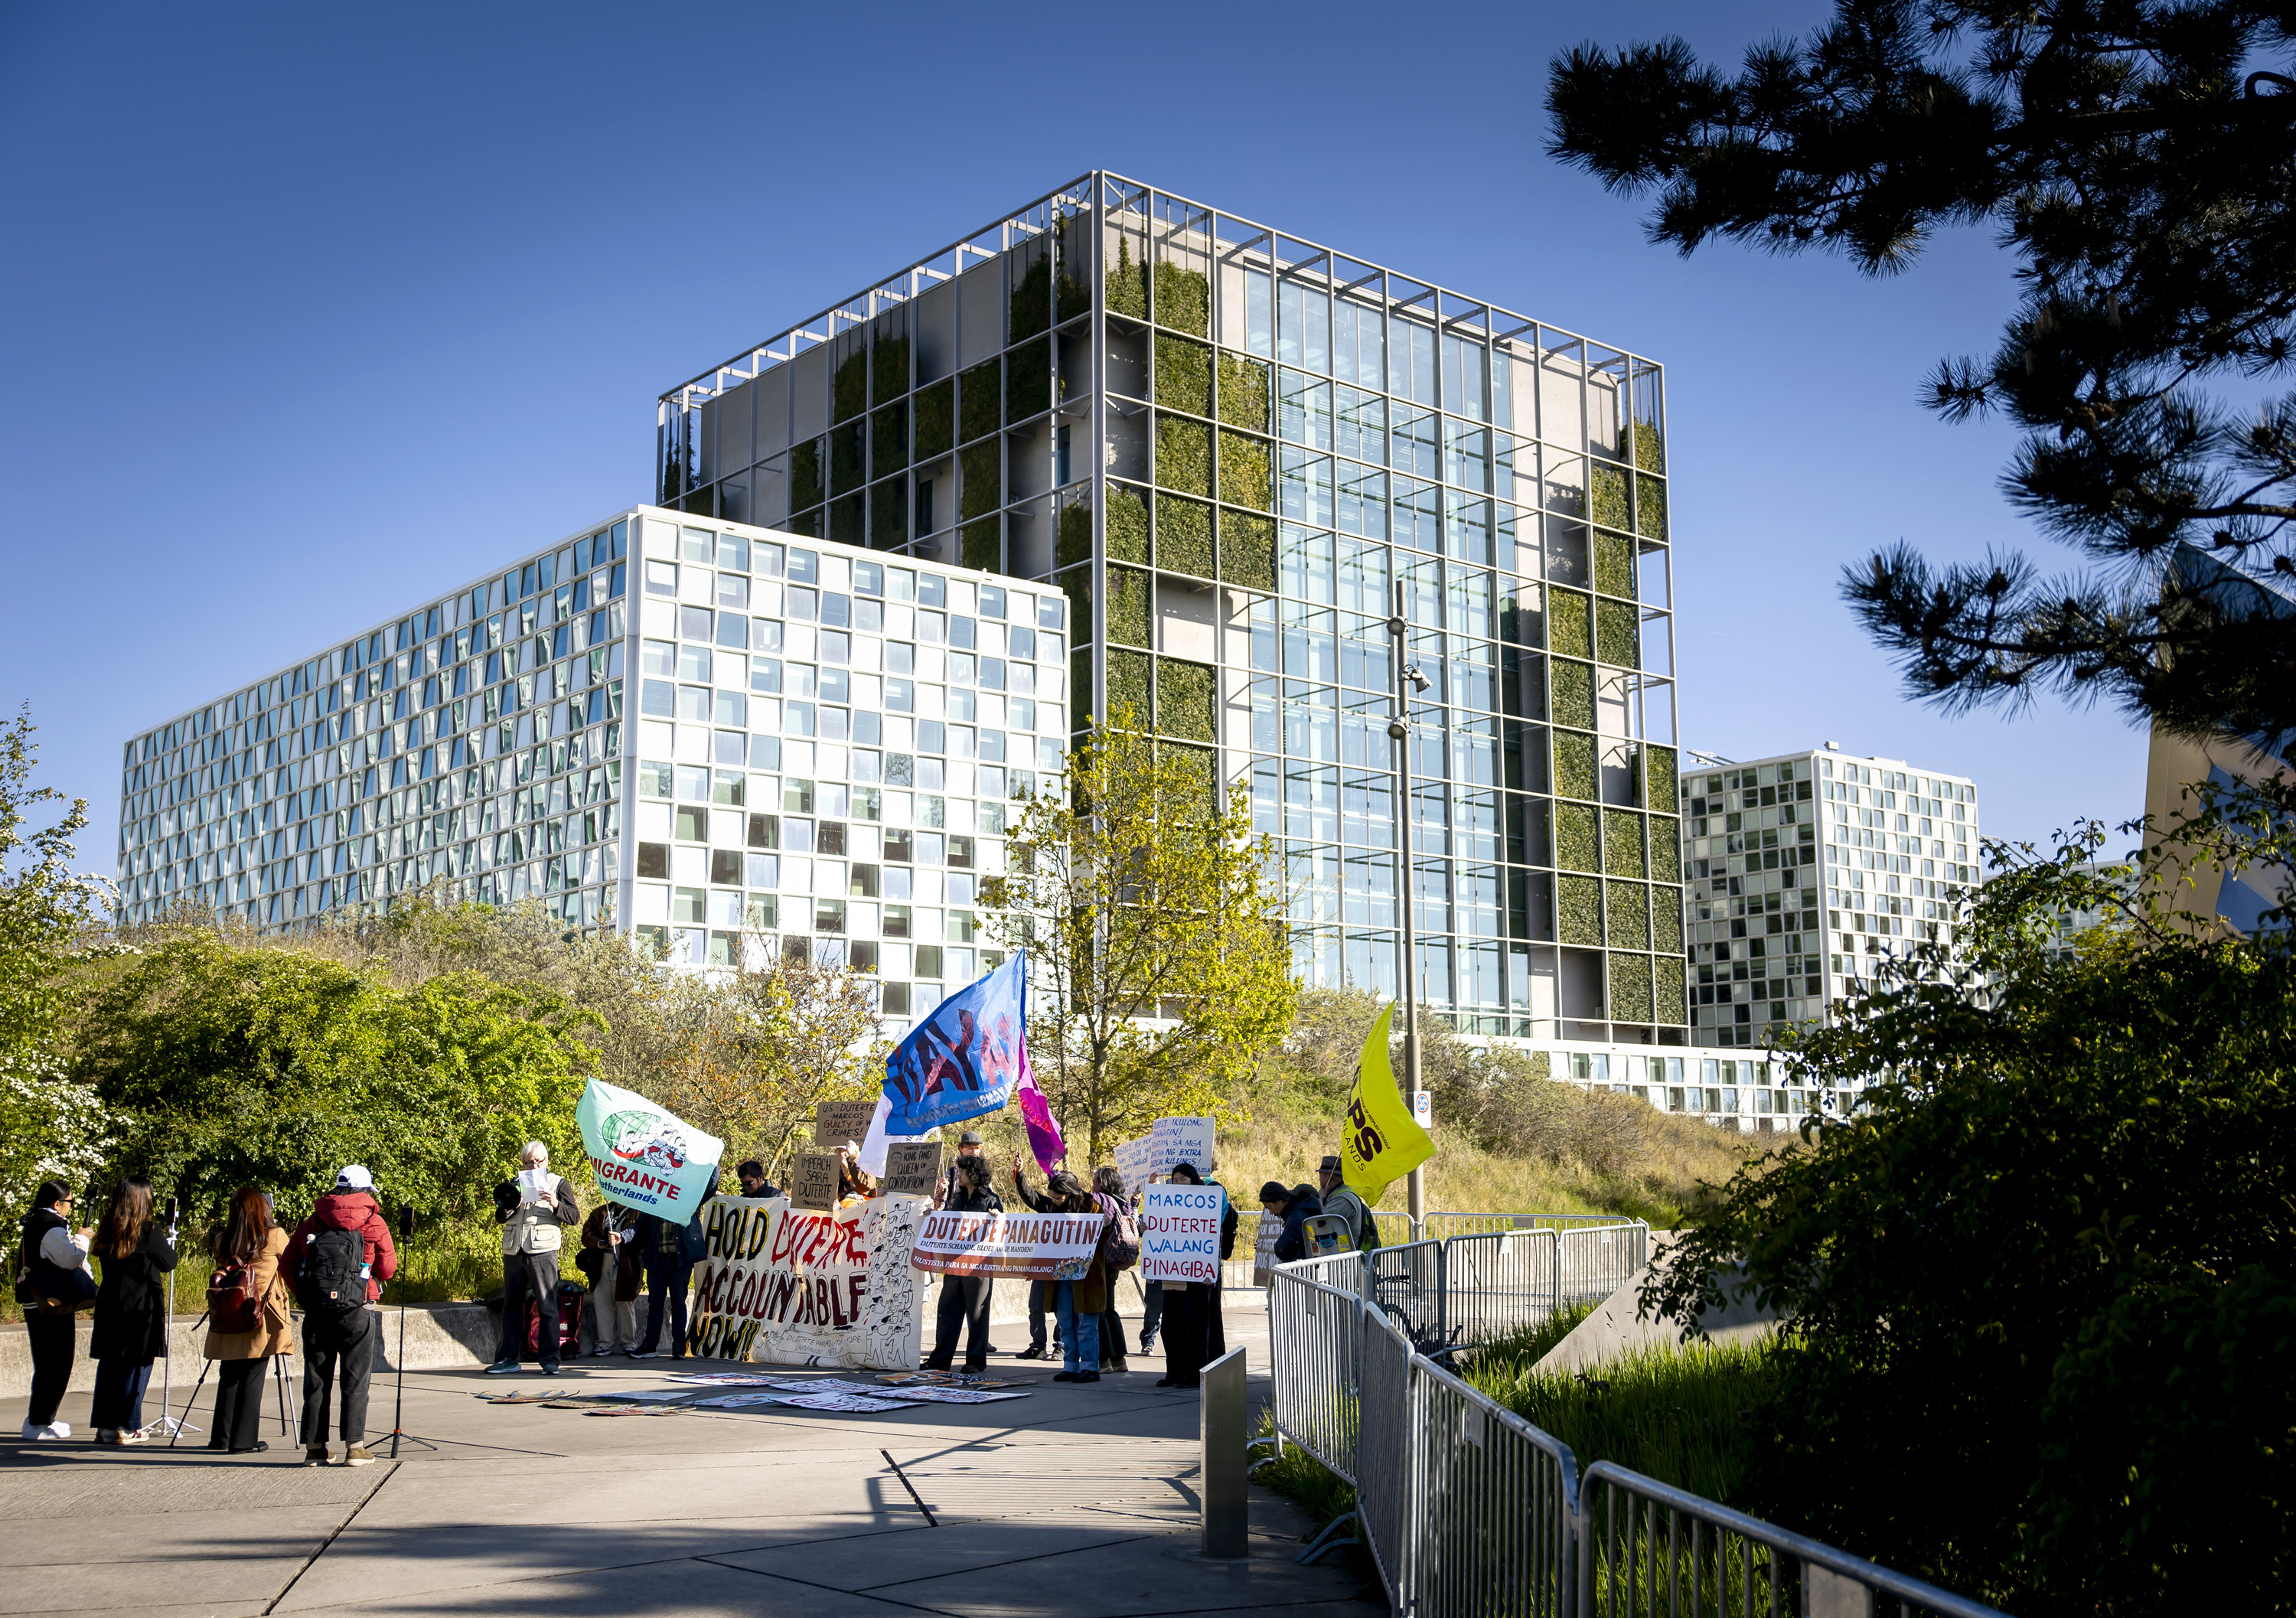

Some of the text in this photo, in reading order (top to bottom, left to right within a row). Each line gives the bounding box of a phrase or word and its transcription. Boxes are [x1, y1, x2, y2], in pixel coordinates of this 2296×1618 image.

[823, 1120, 853, 1128] GUILTY
[827, 1127, 863, 1137] CRIMES!
[801, 1157, 831, 1171] IMPEACH
[903, 1150, 932, 1162] KING AND
[804, 1169, 828, 1183] SARA
[897, 1163, 920, 1175] QUEEN
[590, 1156, 681, 1201] MIGRANTE
[888, 1175, 925, 1189] CORRUPTION
[599, 1179, 658, 1205] etherlands
[798, 1182, 832, 1199] DUTERTE
[1149, 1193, 1216, 1209] MARCOS
[705, 1201, 770, 1262] HOLD
[923, 1216, 1103, 1244] DUTERTE PANAGUTIN!
[1148, 1215, 1218, 1234] DUTERTE
[920, 1241, 947, 1249] DUTERTE
[948, 1242, 976, 1251] SCHANDE,
[1148, 1238, 1214, 1254] WALANG
[914, 1255, 944, 1267] HUSTISYA
[944, 1261, 960, 1269] PARA
[1143, 1258, 1215, 1279] PINAGIBA
[694, 1262, 870, 1326] ACCOUNTABLE
